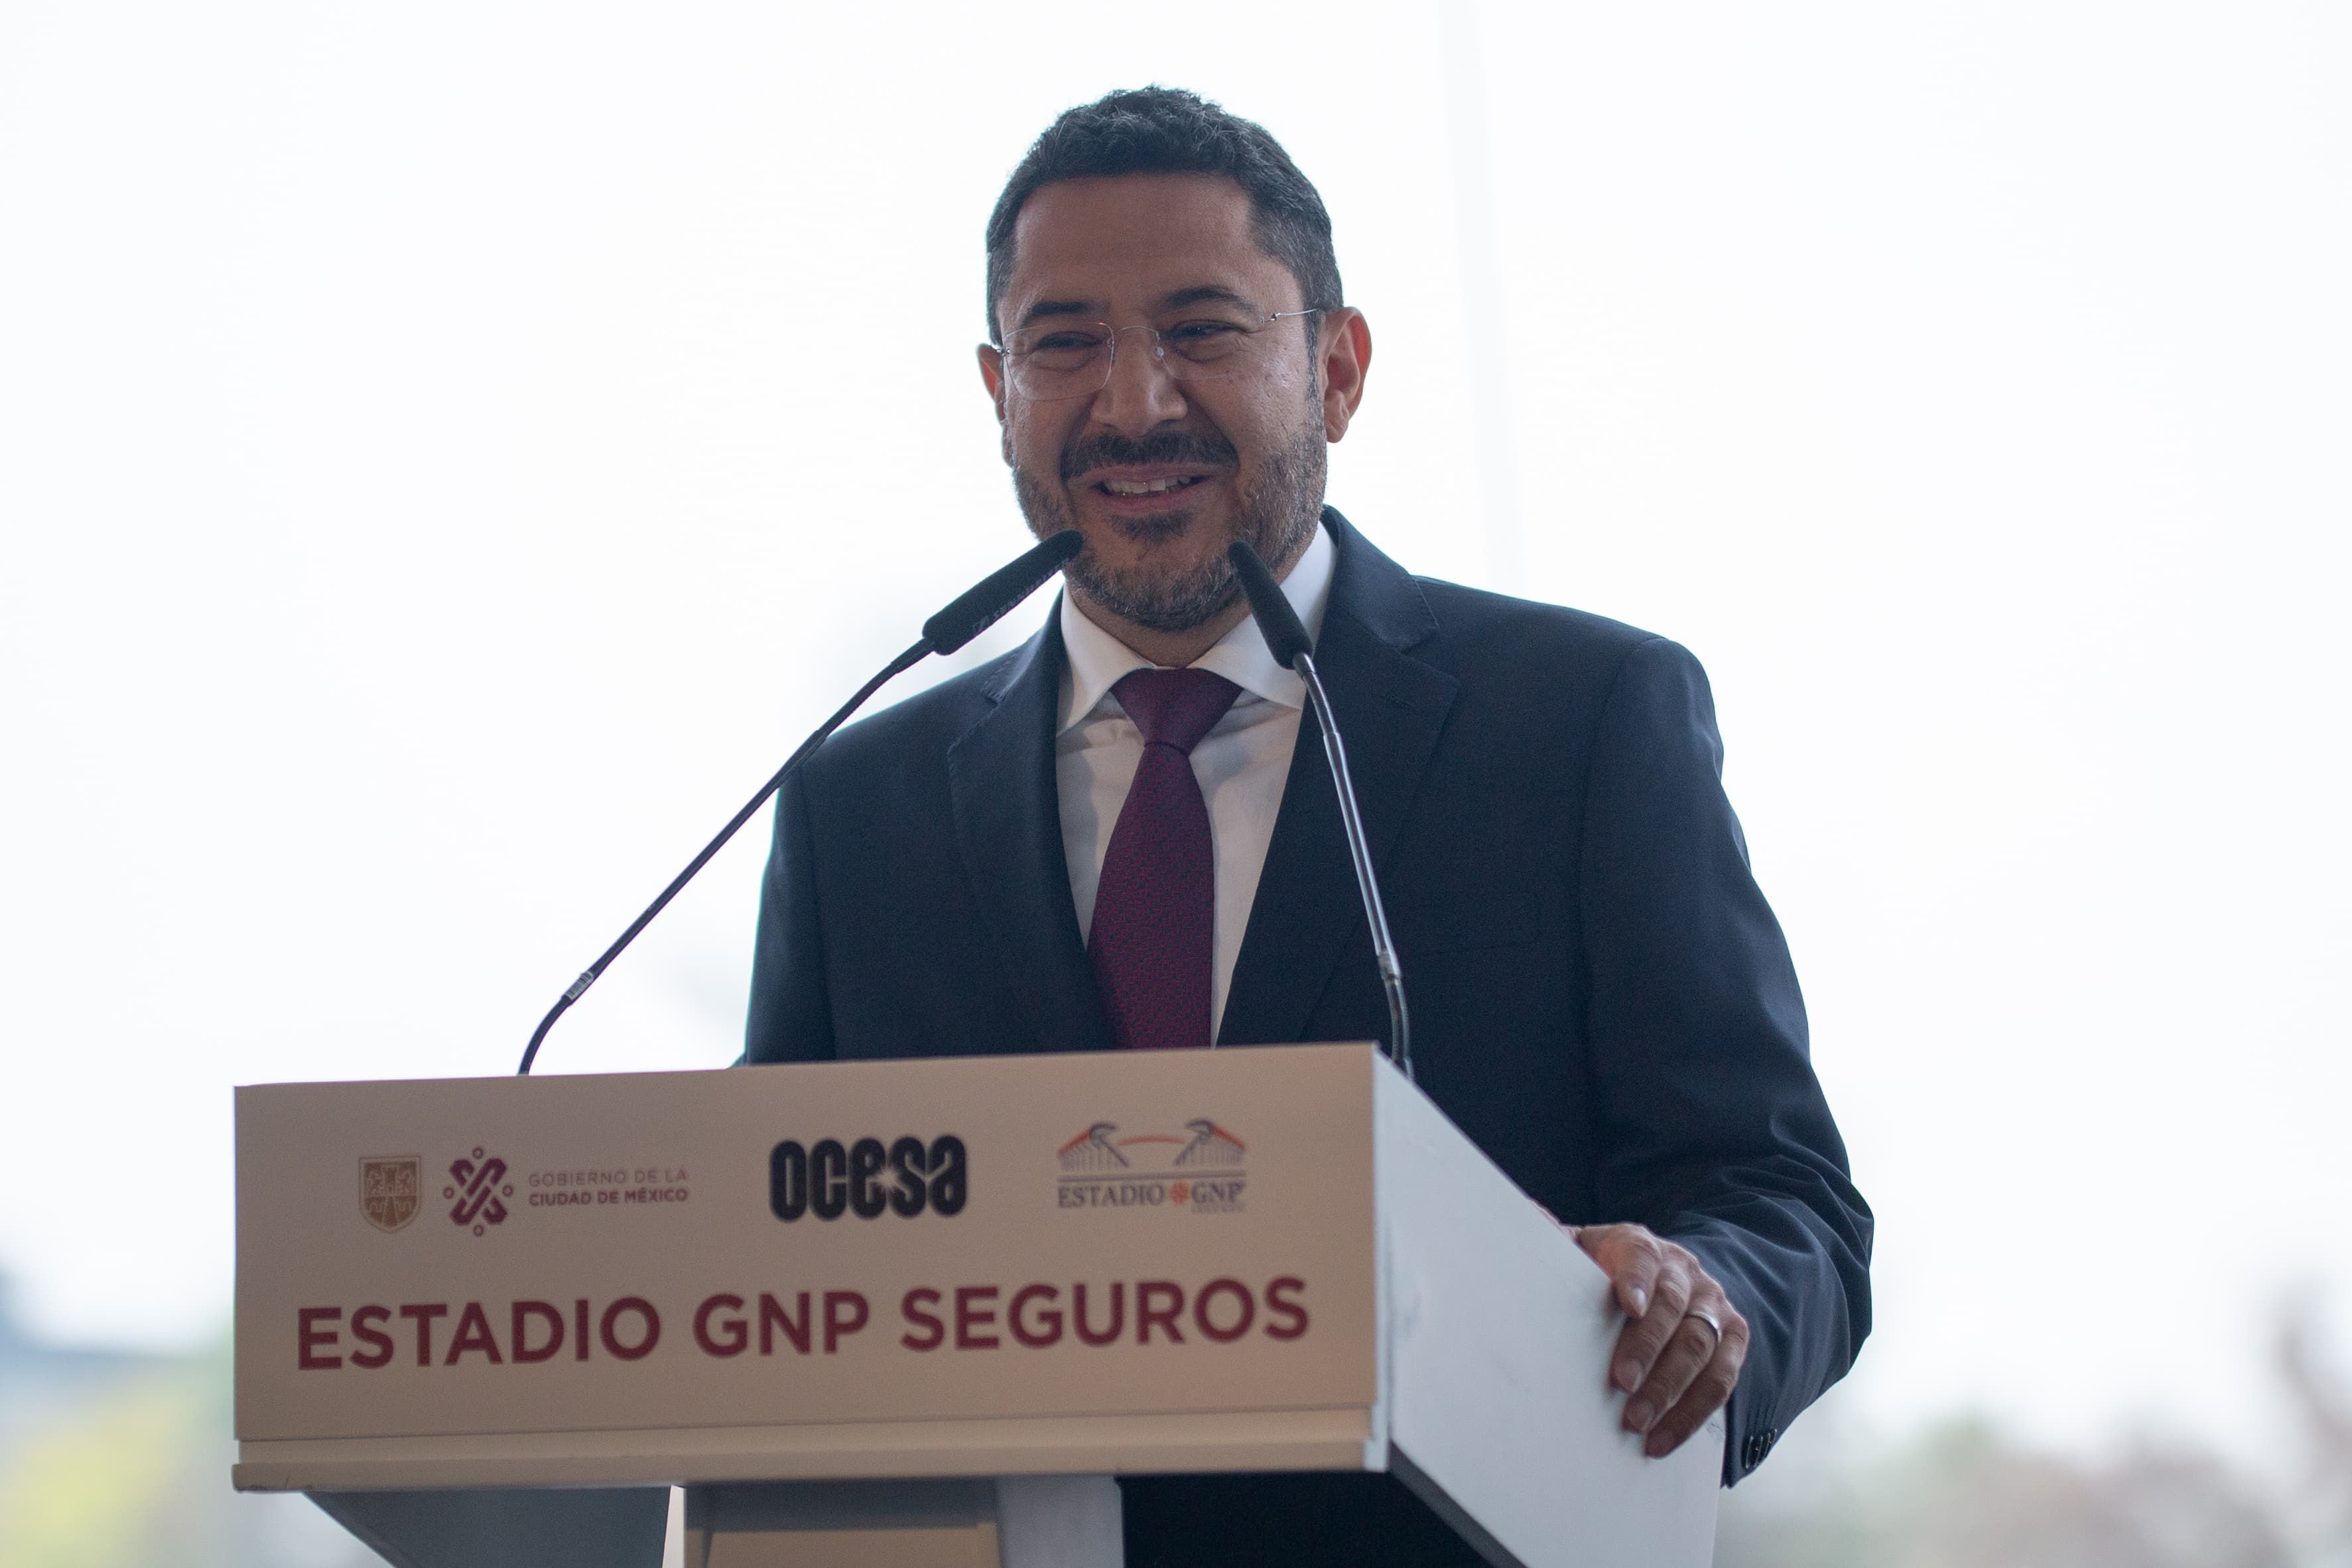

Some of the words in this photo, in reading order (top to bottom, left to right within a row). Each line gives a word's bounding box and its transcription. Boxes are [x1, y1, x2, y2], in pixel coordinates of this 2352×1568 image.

[529, 1170, 626, 1187] GOBIERNO
[635, 1169, 658, 1184] DE
[665, 1168, 688, 1183] LA
[771, 1134, 968, 1222] ocesa
[529, 1191, 592, 1207] CIUDAD
[598, 1191, 619, 1204] DE
[625, 1186, 688, 1203] MÉXICO
[1058, 1183, 1165, 1208] ESTADIO
[1192, 1181, 1246, 1204] GNP
[298, 1295, 661, 1370] ESTADIO
[692, 1292, 870, 1358] GNP
[900, 1277, 1309, 1352] SEGUROS
